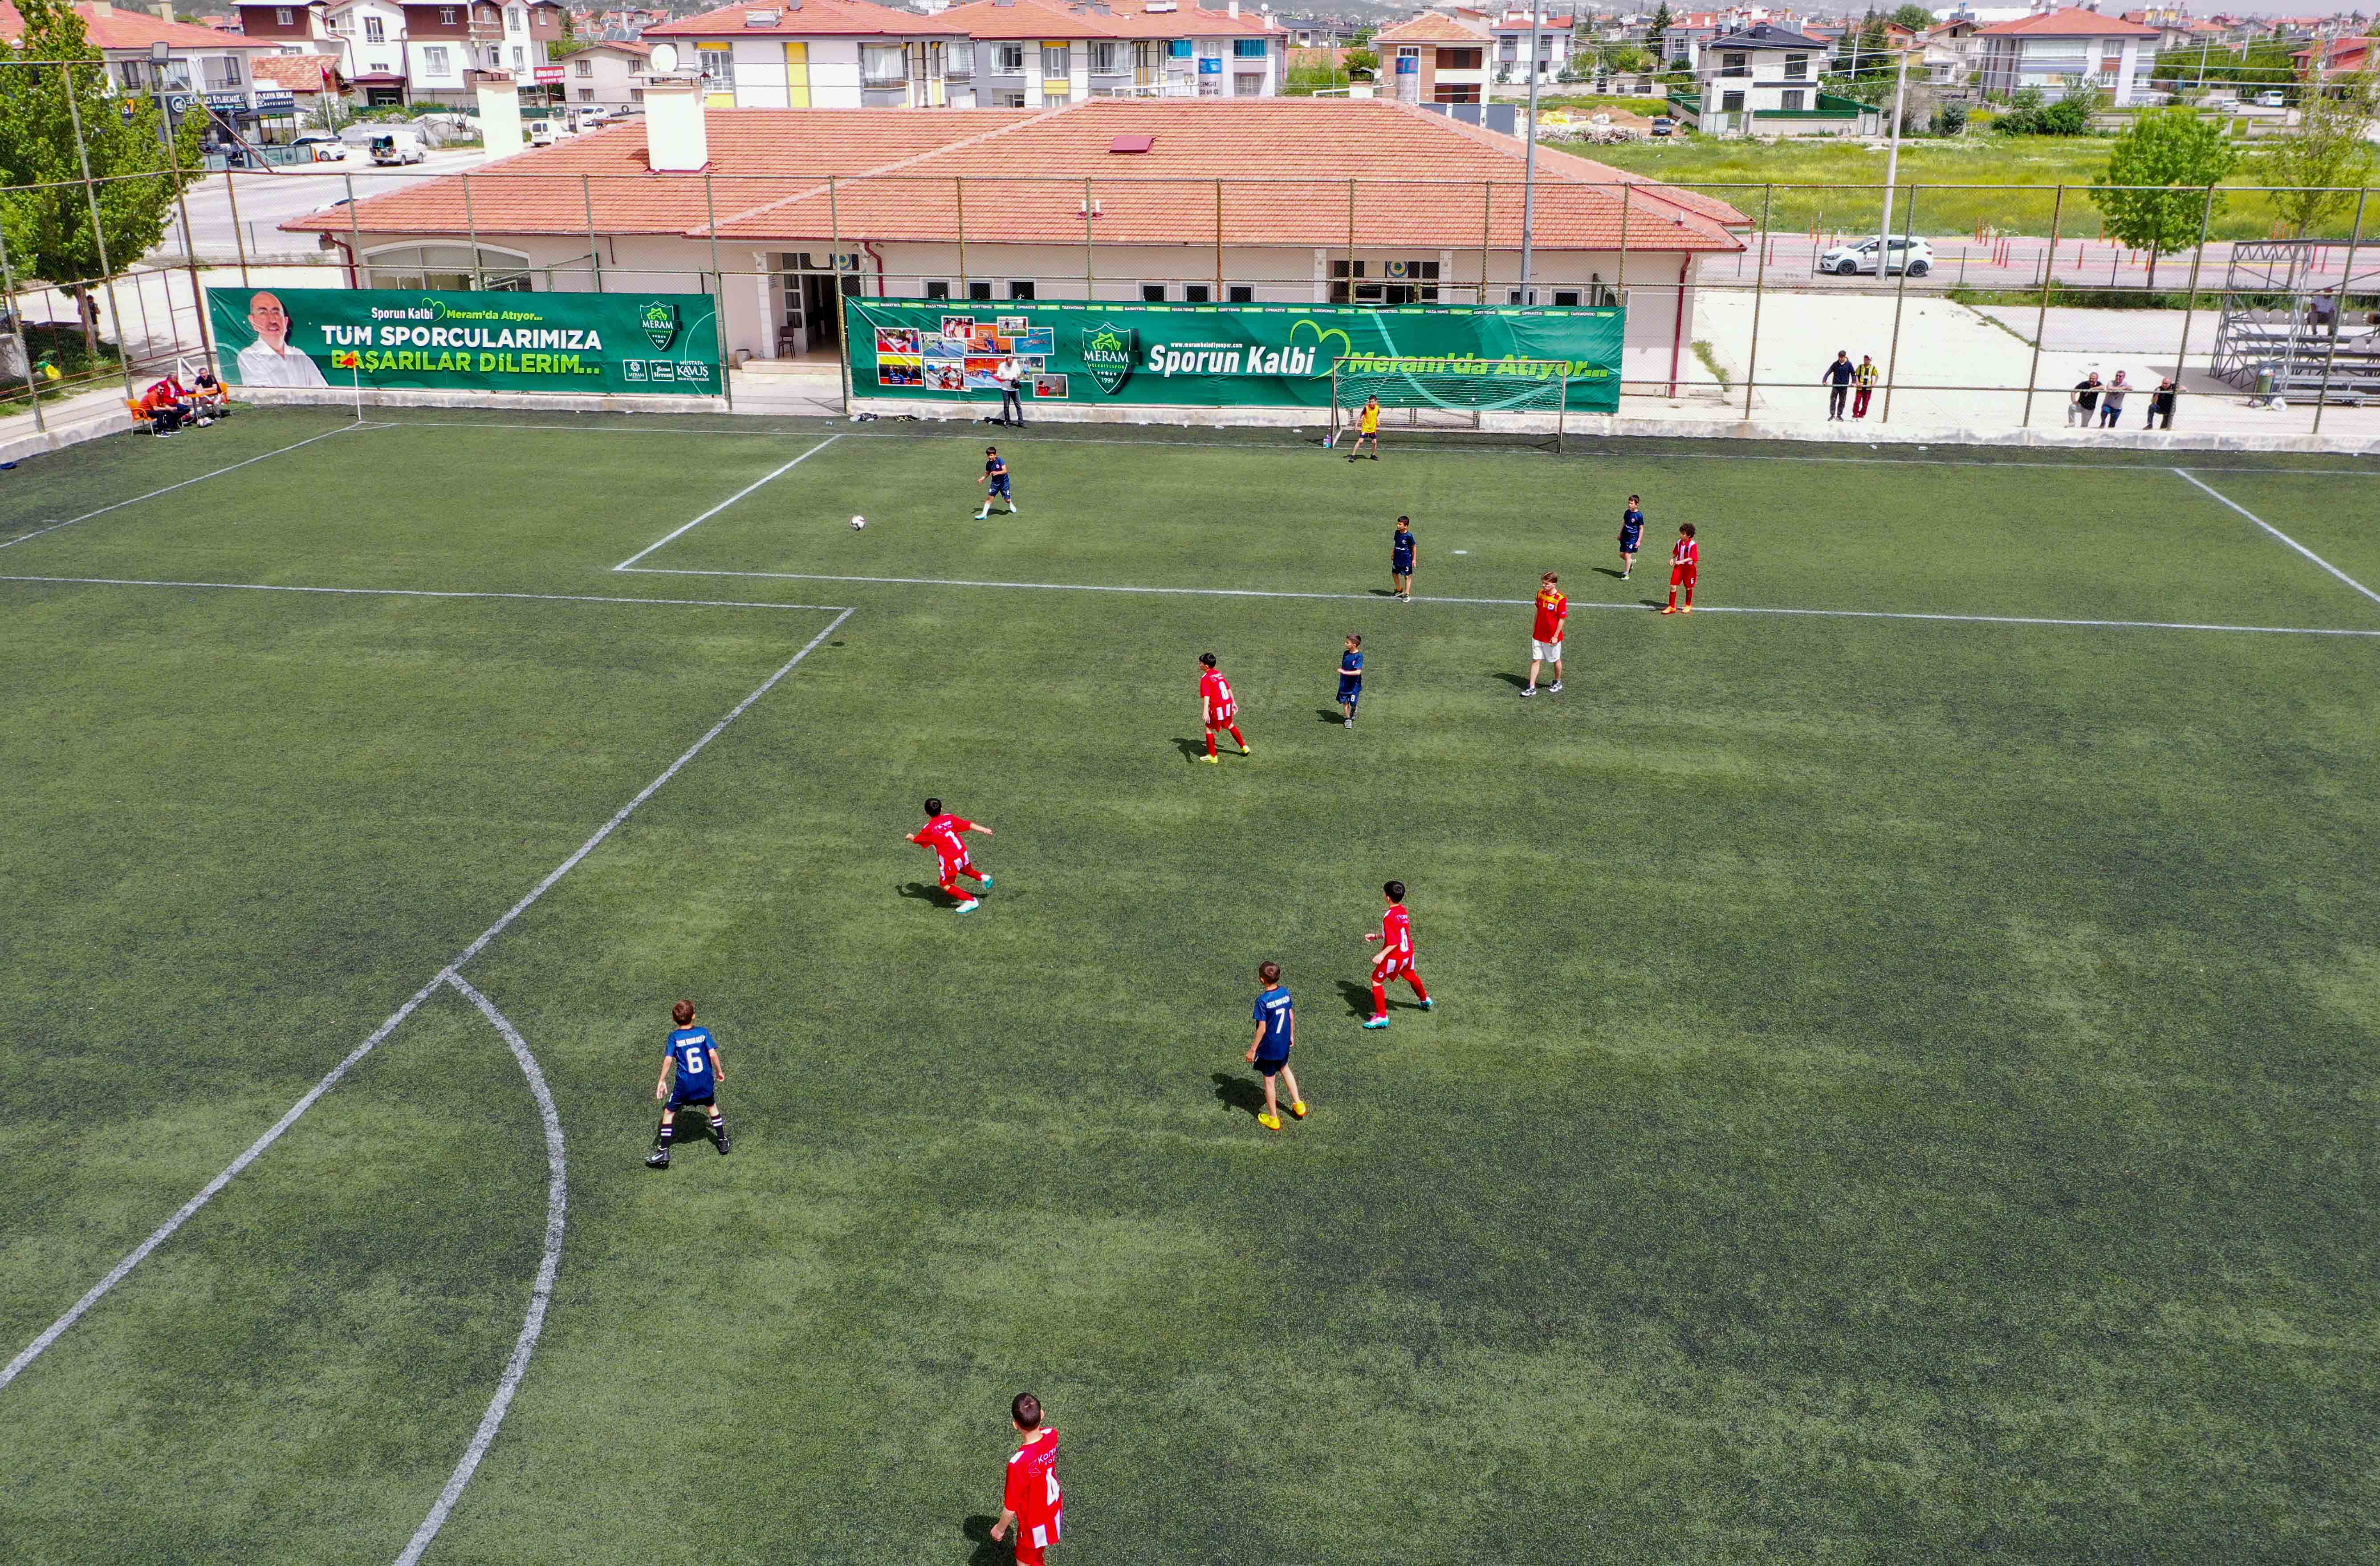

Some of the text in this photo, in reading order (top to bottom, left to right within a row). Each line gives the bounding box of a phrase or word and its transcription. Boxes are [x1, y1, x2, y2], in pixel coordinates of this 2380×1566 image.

[371, 307, 433, 320] Sporun Kalbi
[447, 310, 499, 320] Meram'da
[642, 320, 674, 329] MERAM
[321, 325, 602, 350] TÜM SPORCULARIMIZA
[332, 349, 471, 373] BAŞARILAR
[1083, 349, 1130, 363] MERAM
[1149, 344, 1316, 377] Sporun Kalbi
[1349, 352, 1489, 375] Meram'da
[676, 365, 709, 378] KAVUŞ
[1275, 1007, 1286, 1034] 7
[686, 1047, 704, 1074] 6
